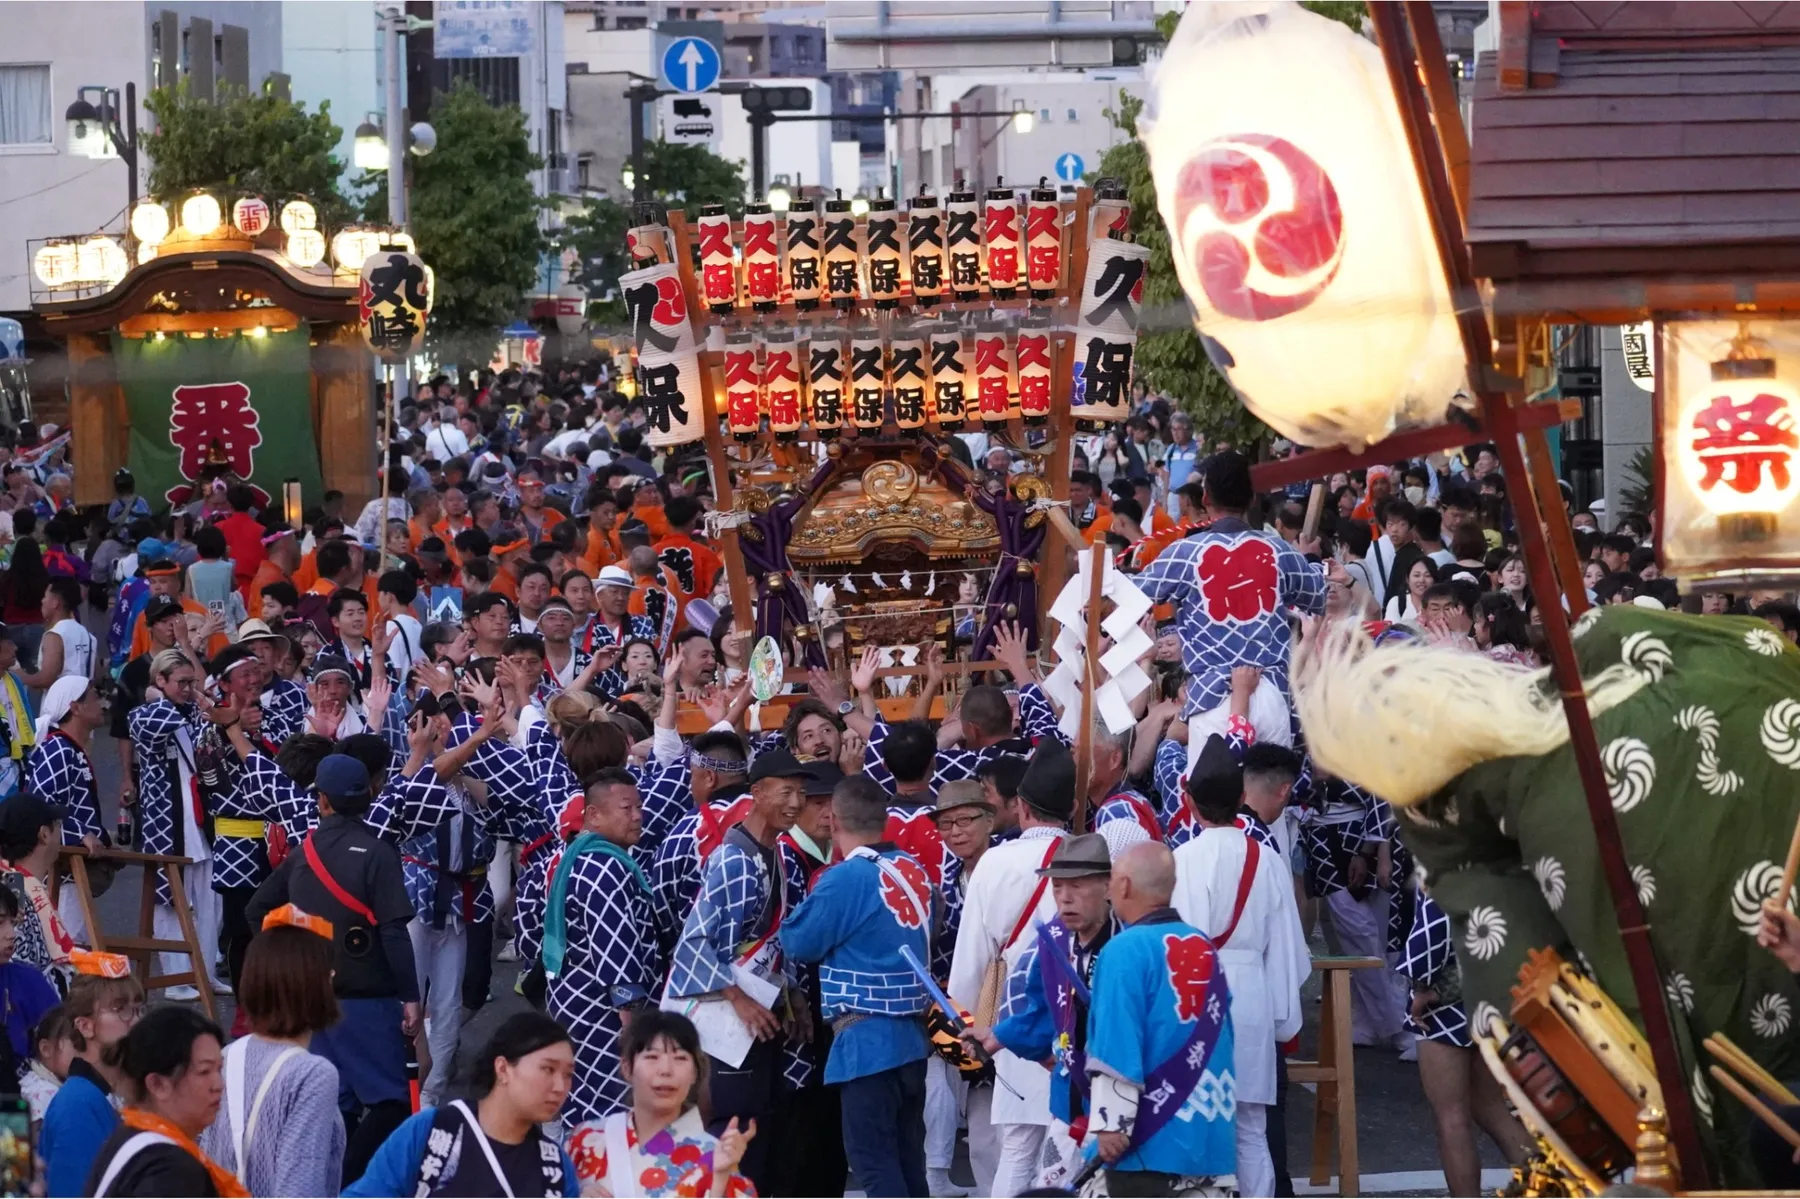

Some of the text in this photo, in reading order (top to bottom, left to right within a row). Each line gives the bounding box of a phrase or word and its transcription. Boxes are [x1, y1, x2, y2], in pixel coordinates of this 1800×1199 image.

[700, 222, 734, 299] 久保
[745, 220, 779, 298] 久保
[788, 219, 819, 290] 久保
[824, 219, 857, 293] 久保
[867, 219, 901, 293] 久保
[909, 215, 942, 289] 久保
[948, 211, 981, 286] 久保
[986, 205, 1018, 283] 久保
[1028, 205, 1060, 283] 久保
[367, 254, 427, 355] 丸崎
[1082, 256, 1145, 407] 久保
[726, 350, 759, 427] 久保
[765, 351, 799, 425] 久保
[810, 348, 843, 424] 久保
[852, 347, 884, 422] 久保
[892, 347, 926, 422] 久保
[931, 340, 964, 415] 久保
[976, 337, 1009, 413] 久保
[1017, 335, 1050, 411] 久保
[1622, 324, 1654, 379] 國屋
[1691, 393, 1800, 493] 祭
[1194, 537, 1279, 626] 祭
